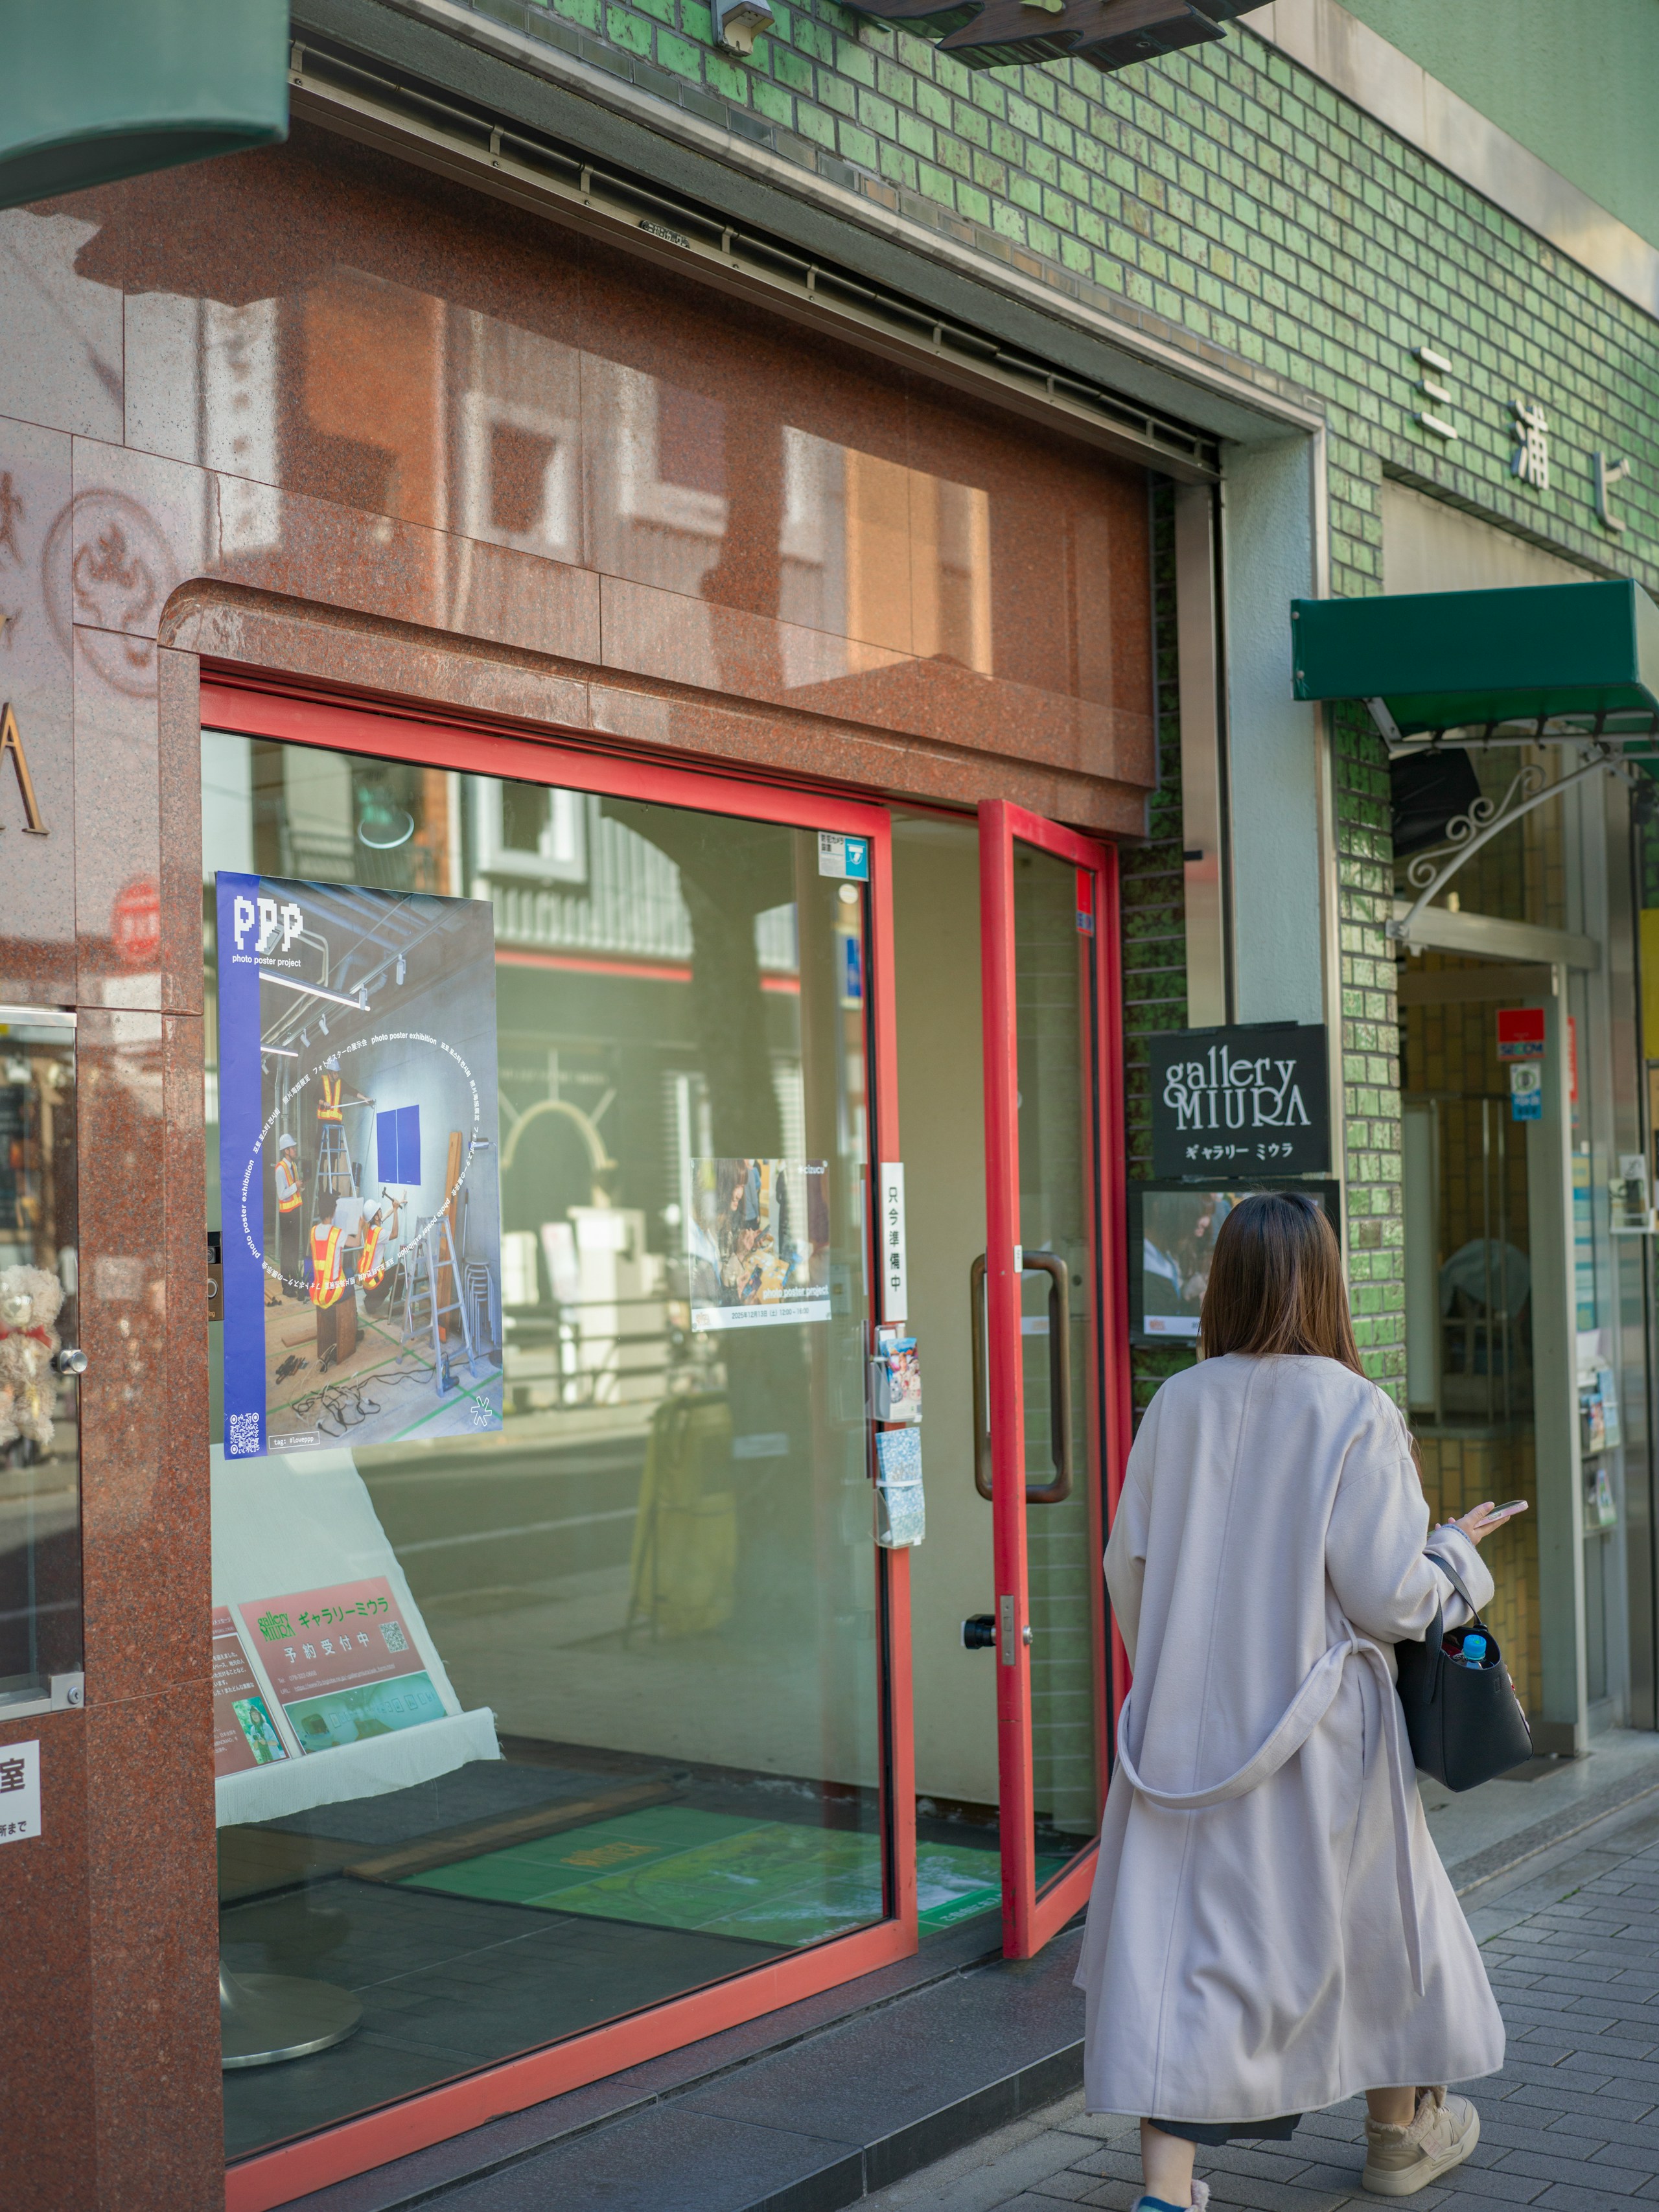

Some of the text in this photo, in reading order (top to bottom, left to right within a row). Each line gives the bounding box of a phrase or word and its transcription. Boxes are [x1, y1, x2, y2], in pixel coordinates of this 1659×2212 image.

[233, 954, 252, 963] photo
[277, 959, 301, 968] project
[371, 1032, 437, 1045] photo poster exhibition
[312, 1038, 367, 1075] フォトポスターの展示会
[441, 1042, 471, 1077] 포토 포스터 전시회
[1163, 1045, 1297, 1108] gallery
[1174, 1084, 1312, 1130] MIURA
[253, 1107, 281, 1154] 포토 포스터 전시회
[1186, 1143, 1293, 1161] ギャラリー ミウラ
[241, 1159, 261, 1259] photo poster exhibition
[397, 1198, 450, 1258] photo poster exhibition
[888, 1187, 901, 1292] 只今準備中
[763, 1285, 829, 1300] photo poster project
[257, 1611, 289, 1629] gallery
[298, 1598, 389, 1629] ギャラリーミウラ
[261, 1624, 297, 1642] MIURA
[284, 1631, 369, 1664] 予約受付中
